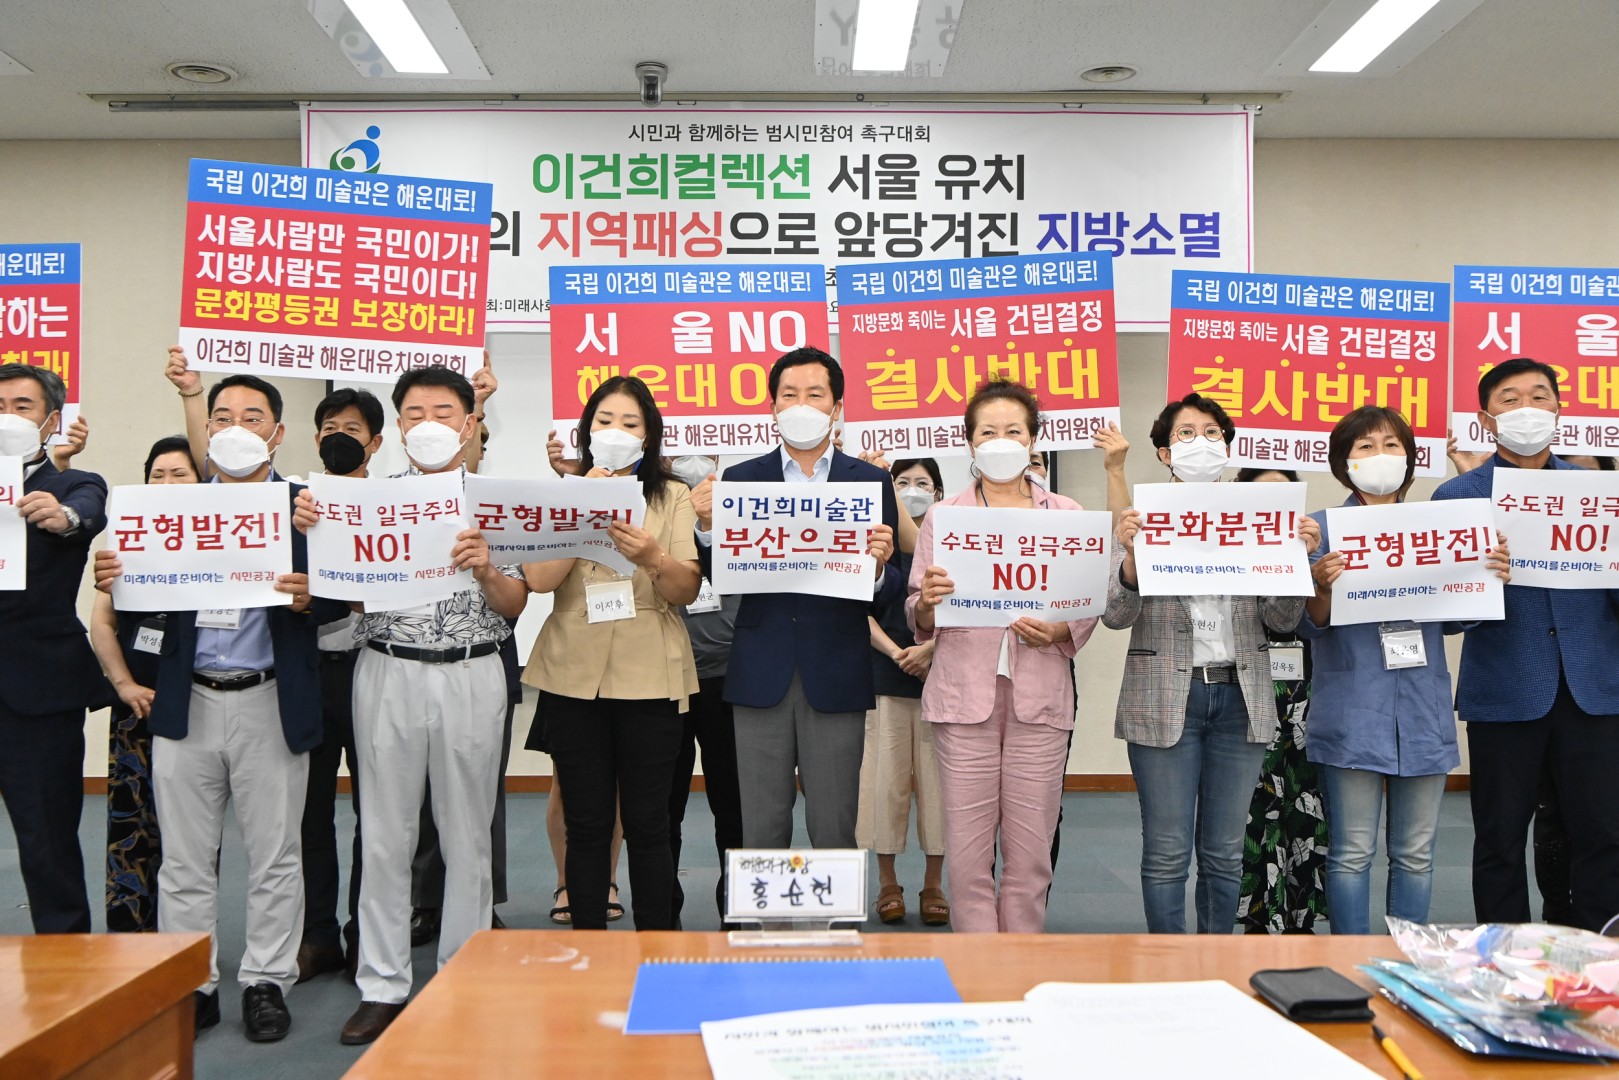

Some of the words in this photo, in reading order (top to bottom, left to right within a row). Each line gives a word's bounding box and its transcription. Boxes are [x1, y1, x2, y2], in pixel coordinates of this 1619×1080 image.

[628, 124, 681, 142] 시민과
[688, 124, 759, 142] 함께하는
[765, 124, 854, 143] 범시민참여
[860, 124, 931, 143] 촉구대회
[206, 168, 243, 195] 국립
[252, 171, 307, 200] 이건희
[316, 177, 390, 207] 미술관은
[397, 183, 477, 213] 해운대로!
[533, 153, 810, 200] 이건희컬렉션
[828, 154, 920, 201] 서울
[935, 154, 1025, 201] 유치
[197, 213, 345, 254] 서울사람만
[356, 226, 480, 264] 국민이가!
[537, 211, 819, 258] 지역패싱으로
[834, 211, 1019, 258] 앞당겨진
[1037, 211, 1221, 258] 지방소멸
[196, 251, 341, 290] 지방사람도
[353, 263, 477, 300] 국민이다!
[565, 273, 598, 295] 국립
[606, 272, 657, 294] 이건희
[664, 271, 732, 294] 미술관은
[738, 270, 811, 293] 해운대로!
[852, 272, 885, 296] 국립
[892, 268, 943, 294] 이건희
[950, 264, 1018, 291] 미술관은
[1024, 260, 1098, 286] 해운대로!
[1469, 272, 1503, 295] 국립
[1510, 273, 1562, 297] 이건희
[1570, 274, 1619, 297] 미술관
[1187, 279, 1220, 303] 국립
[1227, 280, 1278, 306] 이건희
[1285, 283, 1354, 310] 미술관은
[1360, 287, 1435, 313] 해운대로!
[194, 288, 340, 328] 문화평등권
[351, 299, 475, 336] 보장하라!
[852, 311, 904, 334] 지방문화
[907, 309, 946, 331] 죽이는
[950, 306, 997, 338] 서울
[1006, 300, 1103, 336] 건립결정
[728, 310, 807, 353] NO
[1183, 318, 1236, 341] 지방문화
[1239, 320, 1278, 342] 죽이는
[1281, 323, 1330, 356] 서울
[1339, 326, 1436, 362] 건립결정
[196, 337, 251, 365] 이건희
[259, 341, 314, 369] 미술관
[865, 348, 1101, 411] 결사반대
[1191, 366, 1429, 429] 결사반대
[684, 422, 781, 447] 해운대유치위
[861, 427, 911, 453] 이건희
[917, 425, 966, 449] 미술관
[1039, 416, 1105, 443] 치위원회
[1238, 436, 1289, 461] 미술관
[314, 500, 363, 526] 수도권
[376, 497, 461, 527] 일극주의
[473, 502, 633, 533] 균형발전!
[722, 496, 874, 523] 이건희미술관
[1497, 493, 1564, 517] 수도권
[1580, 496, 1619, 518] 일극
[114, 511, 281, 552] 균형발전!
[719, 526, 873, 559] 부산으로!
[941, 531, 1003, 555] 수도권
[1018, 535, 1104, 557] 일극주의
[1141, 511, 1296, 546] 문화분권!
[1550, 524, 1610, 552] NO!
[353, 533, 411, 563] NO!
[1339, 526, 1492, 571] 균형발전!
[230, 571, 276, 582] 시민공감
[414, 565, 456, 580] 시민공감
[823, 562, 863, 574] 시민공감
[992, 563, 1048, 591] NO!
[1252, 564, 1294, 574] 시민공감
[1050, 597, 1092, 609] 시민공감
[1442, 582, 1485, 594] 시민공감
